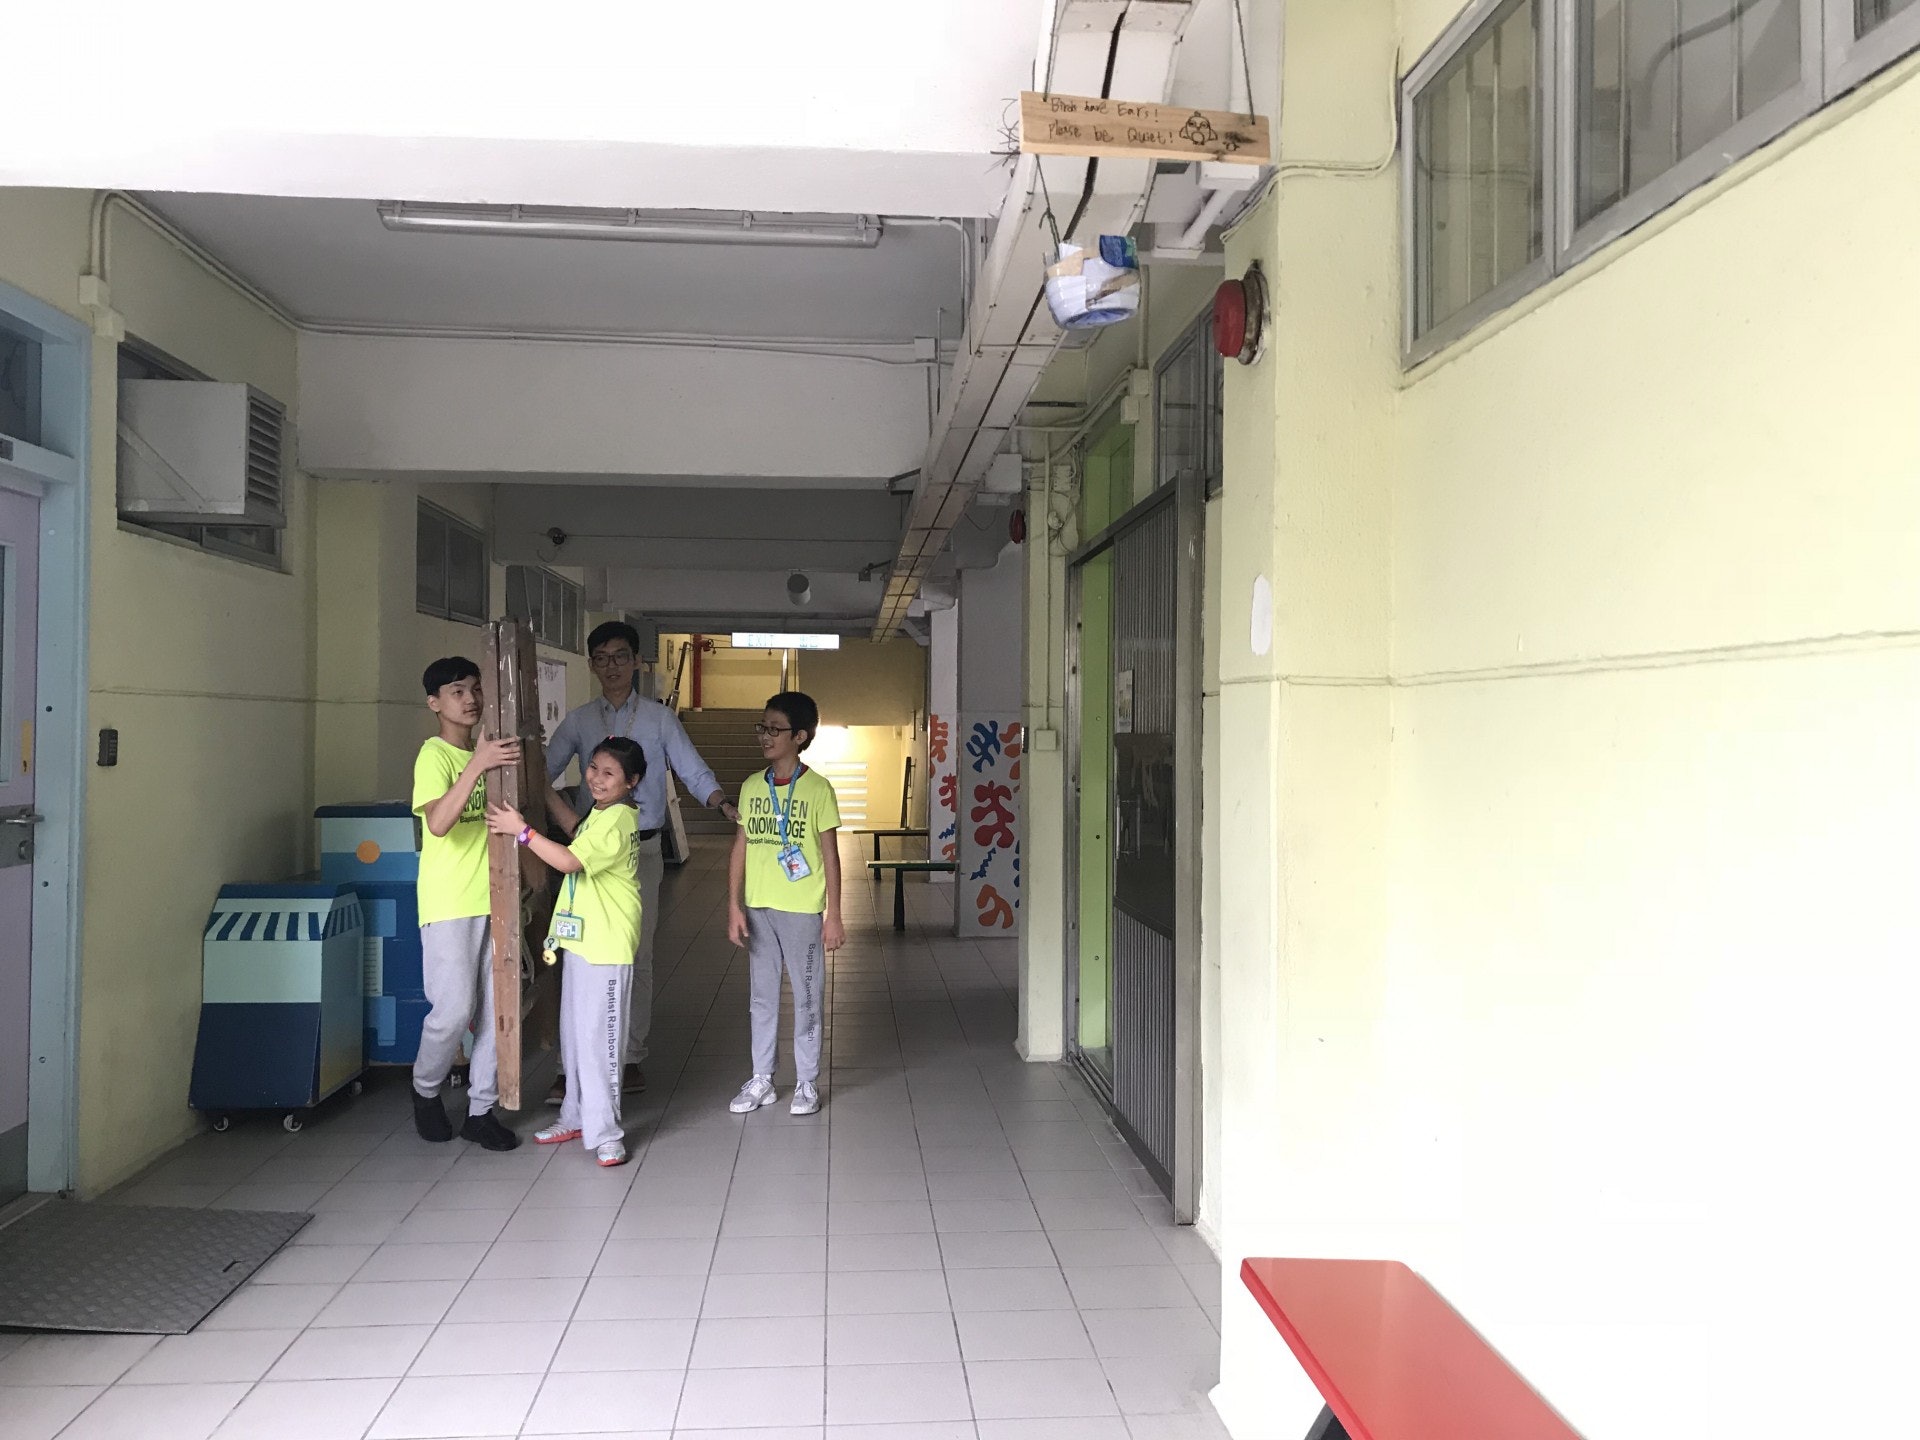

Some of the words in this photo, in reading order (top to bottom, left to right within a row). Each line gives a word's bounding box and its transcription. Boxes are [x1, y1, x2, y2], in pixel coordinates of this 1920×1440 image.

[1084, 101, 1109, 115] have
[1117, 102, 1159, 123] Ears!
[1093, 125, 1114, 143] be
[1127, 127, 1174, 144] Quiet!
[747, 633, 776, 647] EXIT
[806, 943, 816, 973] Baptist
[606, 979, 617, 1013] Baptist
[607, 1016, 617, 1059] Rainbow
